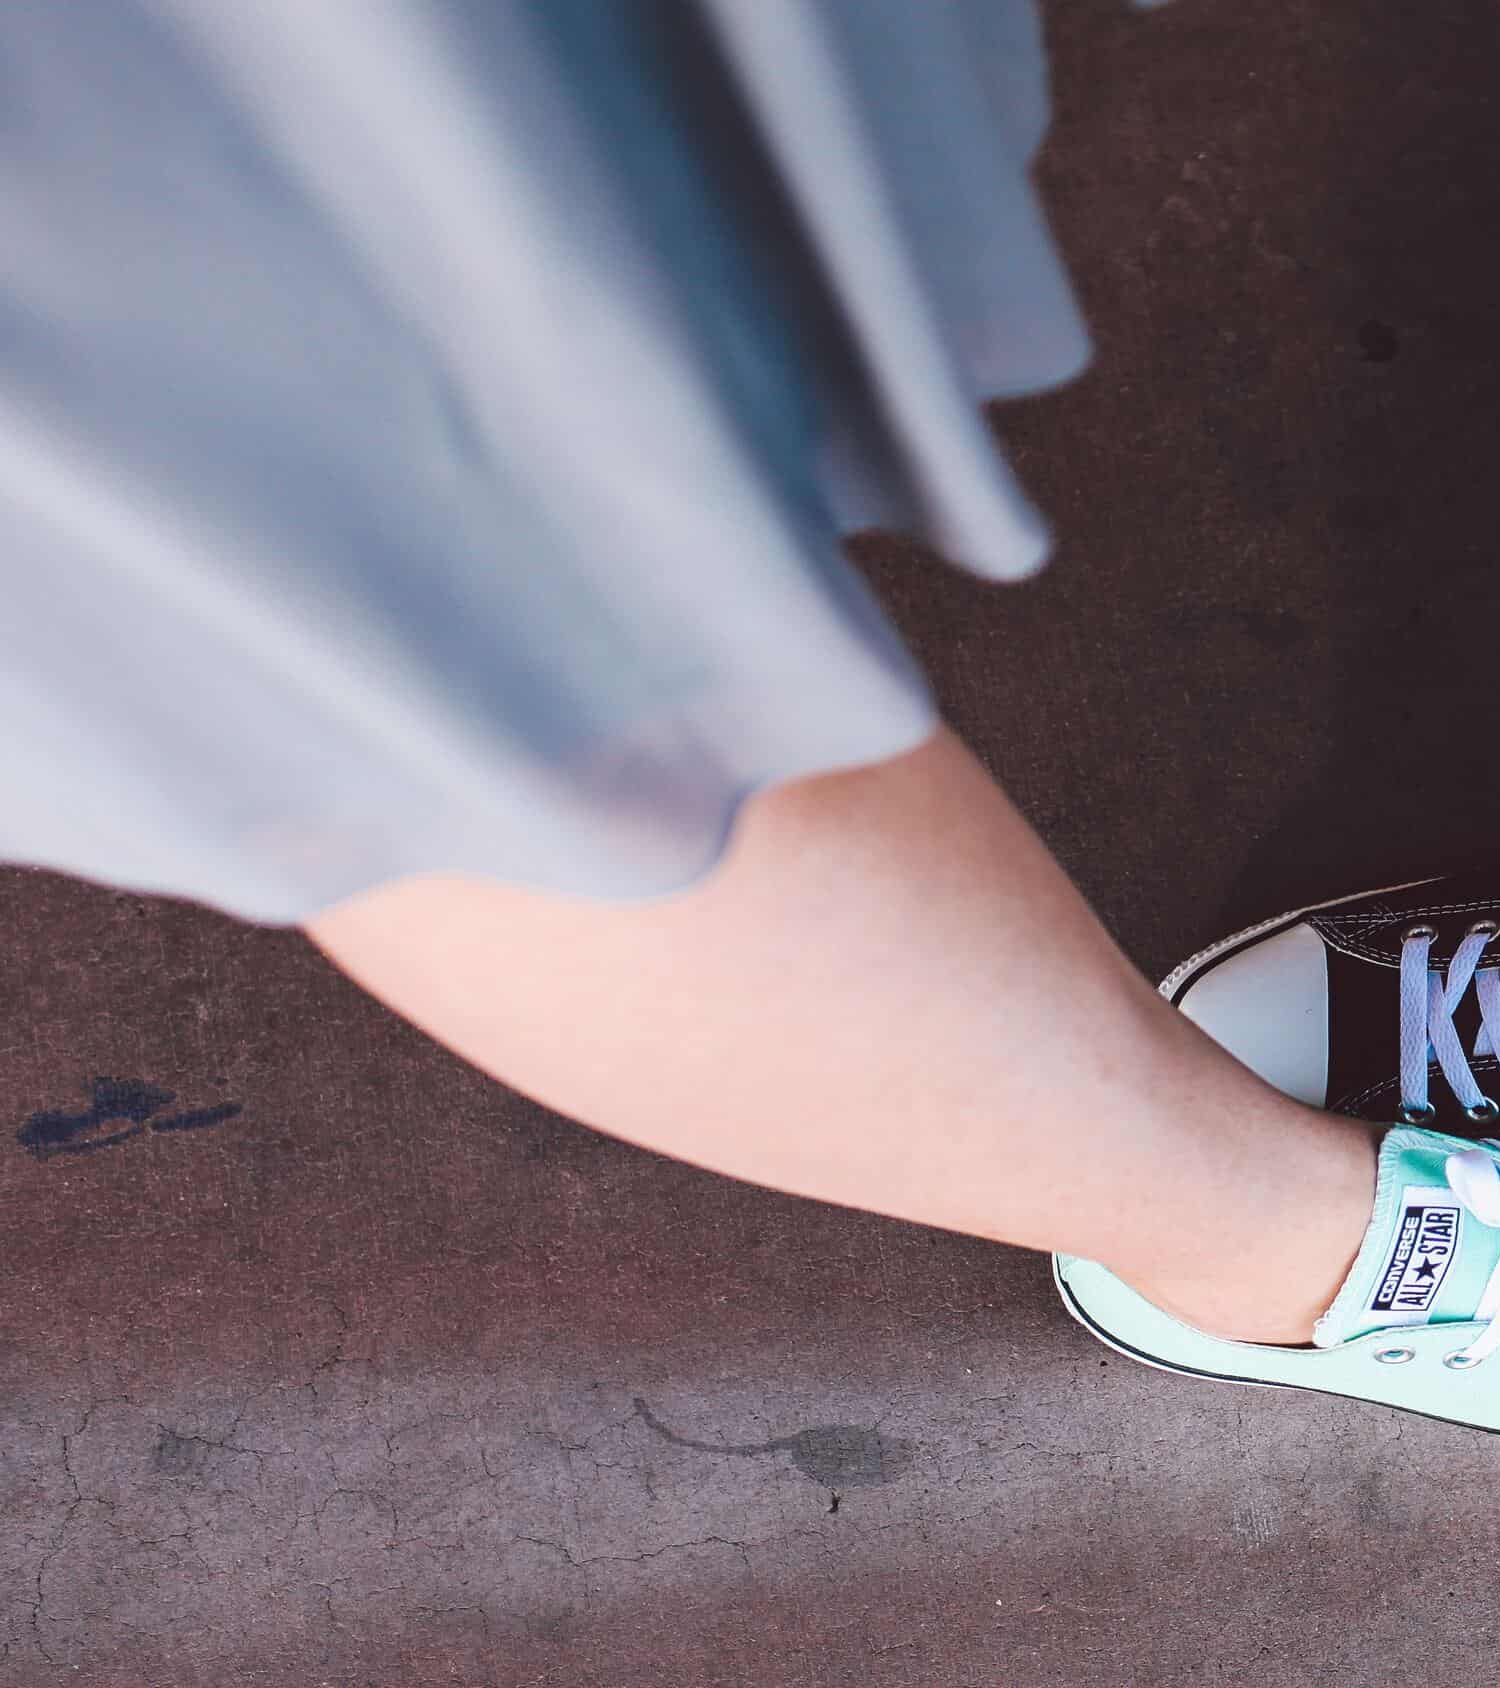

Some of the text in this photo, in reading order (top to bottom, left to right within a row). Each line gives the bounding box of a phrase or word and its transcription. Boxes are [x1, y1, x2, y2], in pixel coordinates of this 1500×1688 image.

[1378, 1216, 1420, 1303] CONVERSE
[1396, 1212, 1455, 1306] ALL STAR
